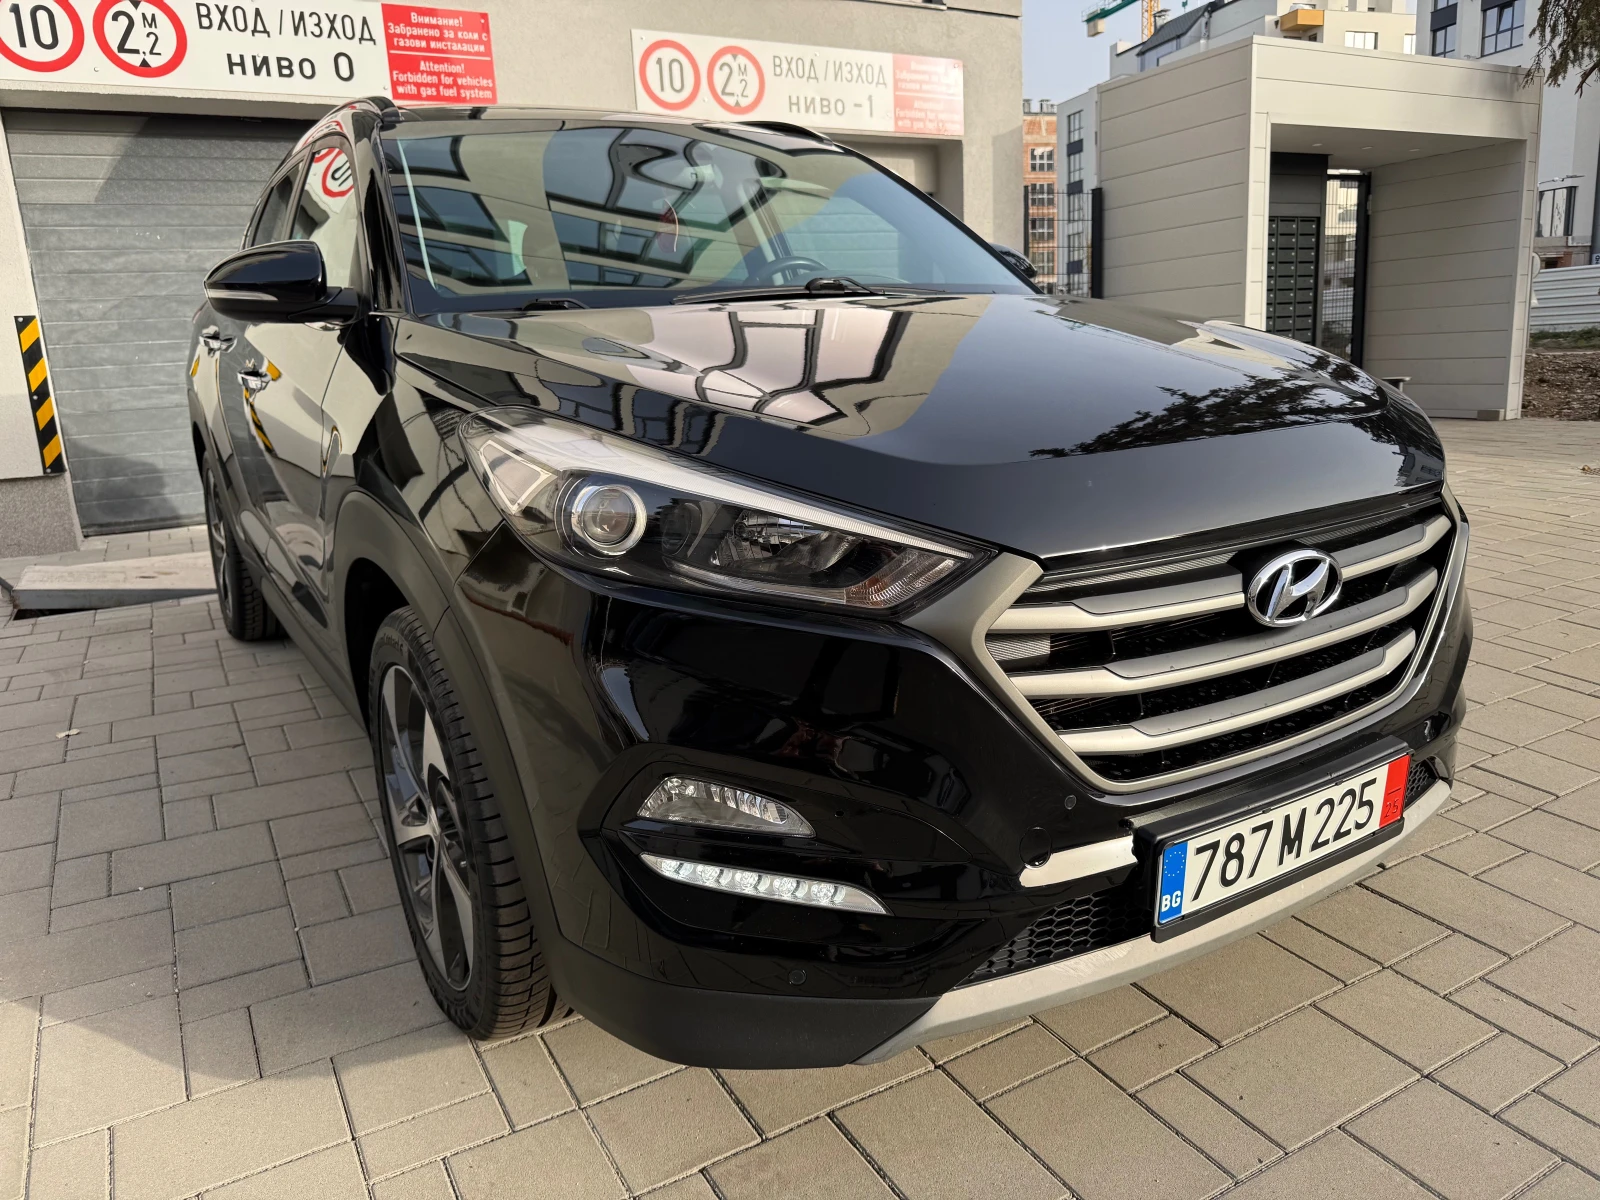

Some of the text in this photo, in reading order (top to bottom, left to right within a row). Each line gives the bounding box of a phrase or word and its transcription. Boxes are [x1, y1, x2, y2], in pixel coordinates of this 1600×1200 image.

[9, 3, 59, 50] 10
[195, 2, 271, 38] ВХОД
[291, 10, 377, 46] ИЗХОД
[410, 12, 463, 27] Внимание!
[388, 23, 440, 37] Забранено
[443, 30, 454, 38] за
[458, 31, 479, 40] коли
[393, 37, 485, 53] газови инсталации
[420, 60, 465, 73] Attention!
[656, 57, 685, 93] 10
[773, 55, 819, 83] ВХОД
[833, 60, 887, 89] ИЗХОД
[393, 71, 493, 87] Forbidden for vehicles
[396, 84, 492, 99] with gas fuel system
[1384, 798, 1400, 819] 25
[1160, 890, 1181, 912] BG
